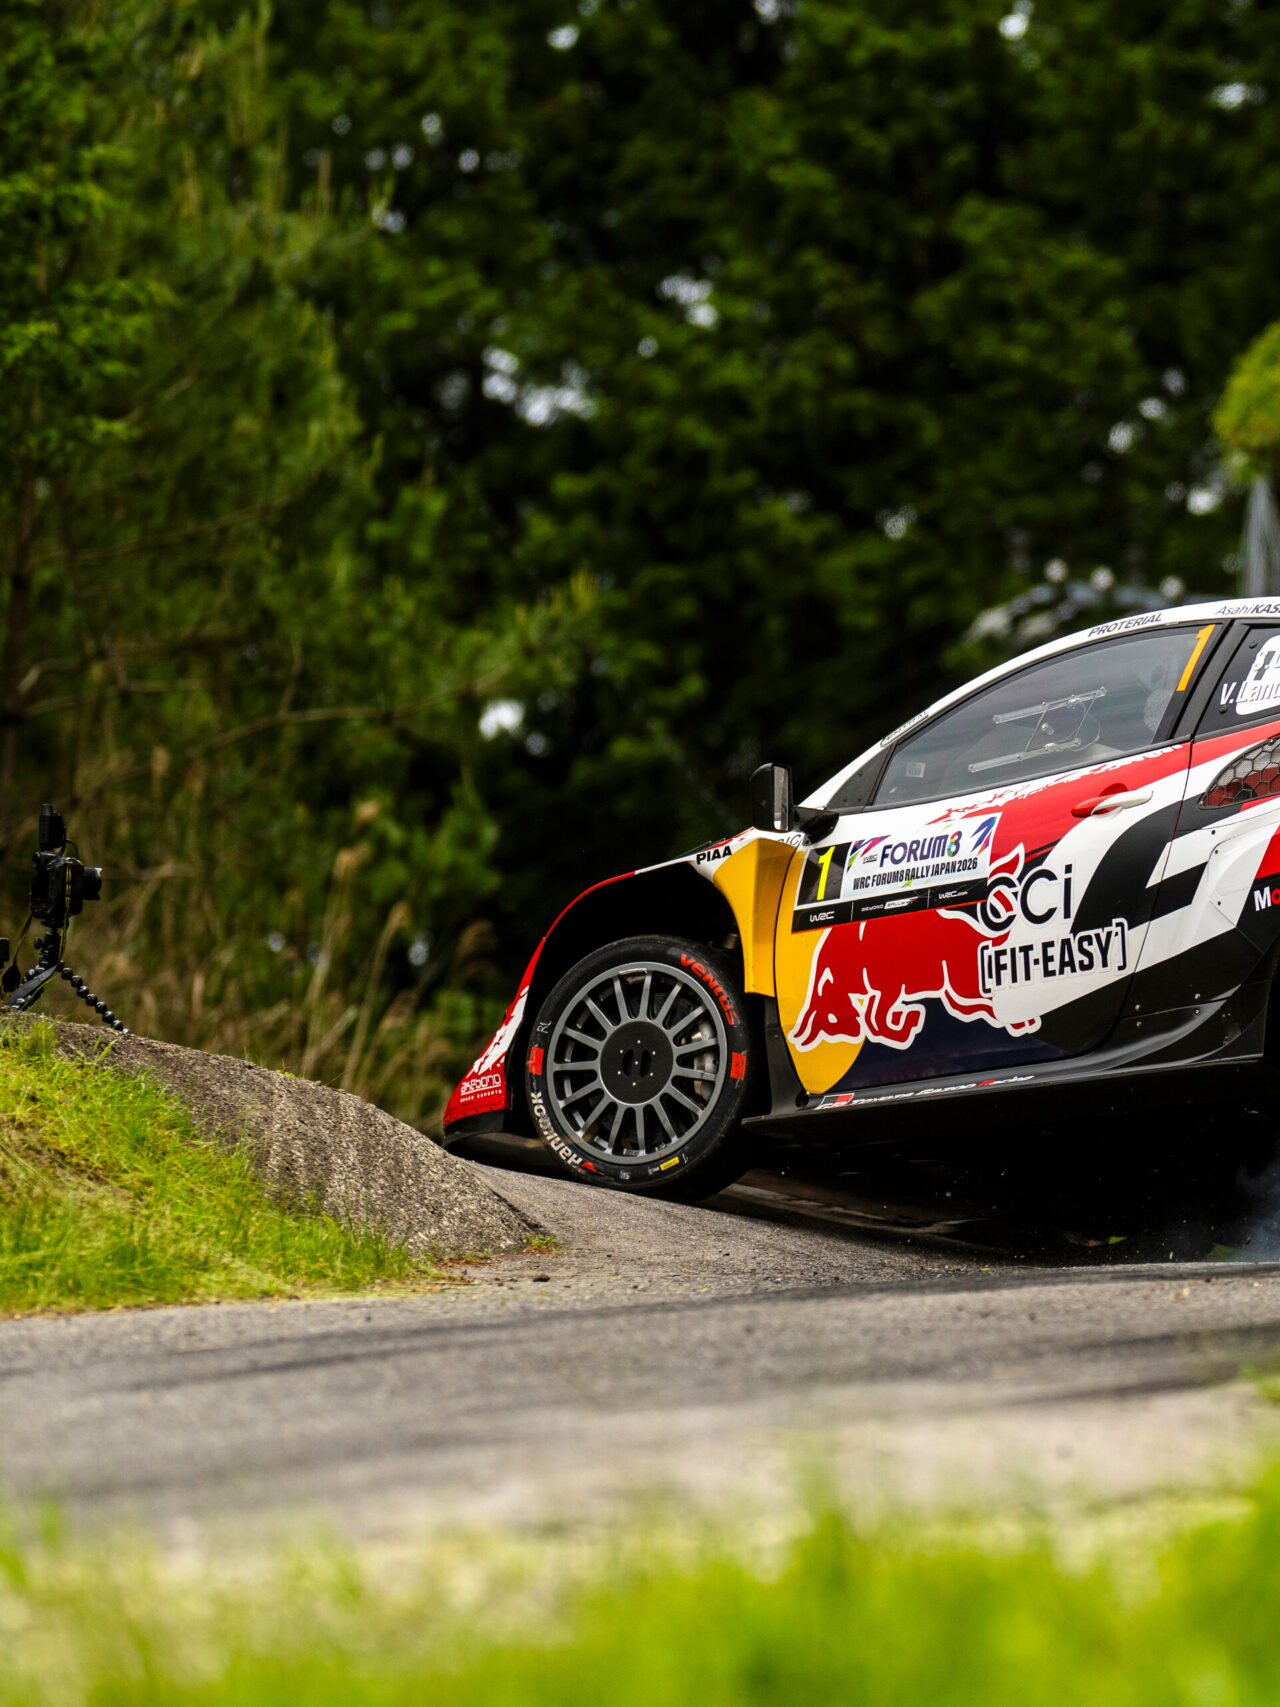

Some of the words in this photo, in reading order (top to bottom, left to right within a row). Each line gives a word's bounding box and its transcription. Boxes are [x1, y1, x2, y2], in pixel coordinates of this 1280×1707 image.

[1087, 613, 1163, 638] PROTERIAL
[1176, 623, 1216, 692] 1
[696, 845, 733, 865] PIAA
[880, 830, 962, 868] FORUM8
[816, 846, 836, 901] 1
[853, 877, 870, 890] WRC
[871, 870, 904, 887] FORUM8
[905, 864, 931, 880] RALLY
[931, 860, 957, 877] JAPAN
[957, 856, 978, 871] 2026
[809, 910, 835, 923] WRC
[460, 1073, 502, 1093] akebono
